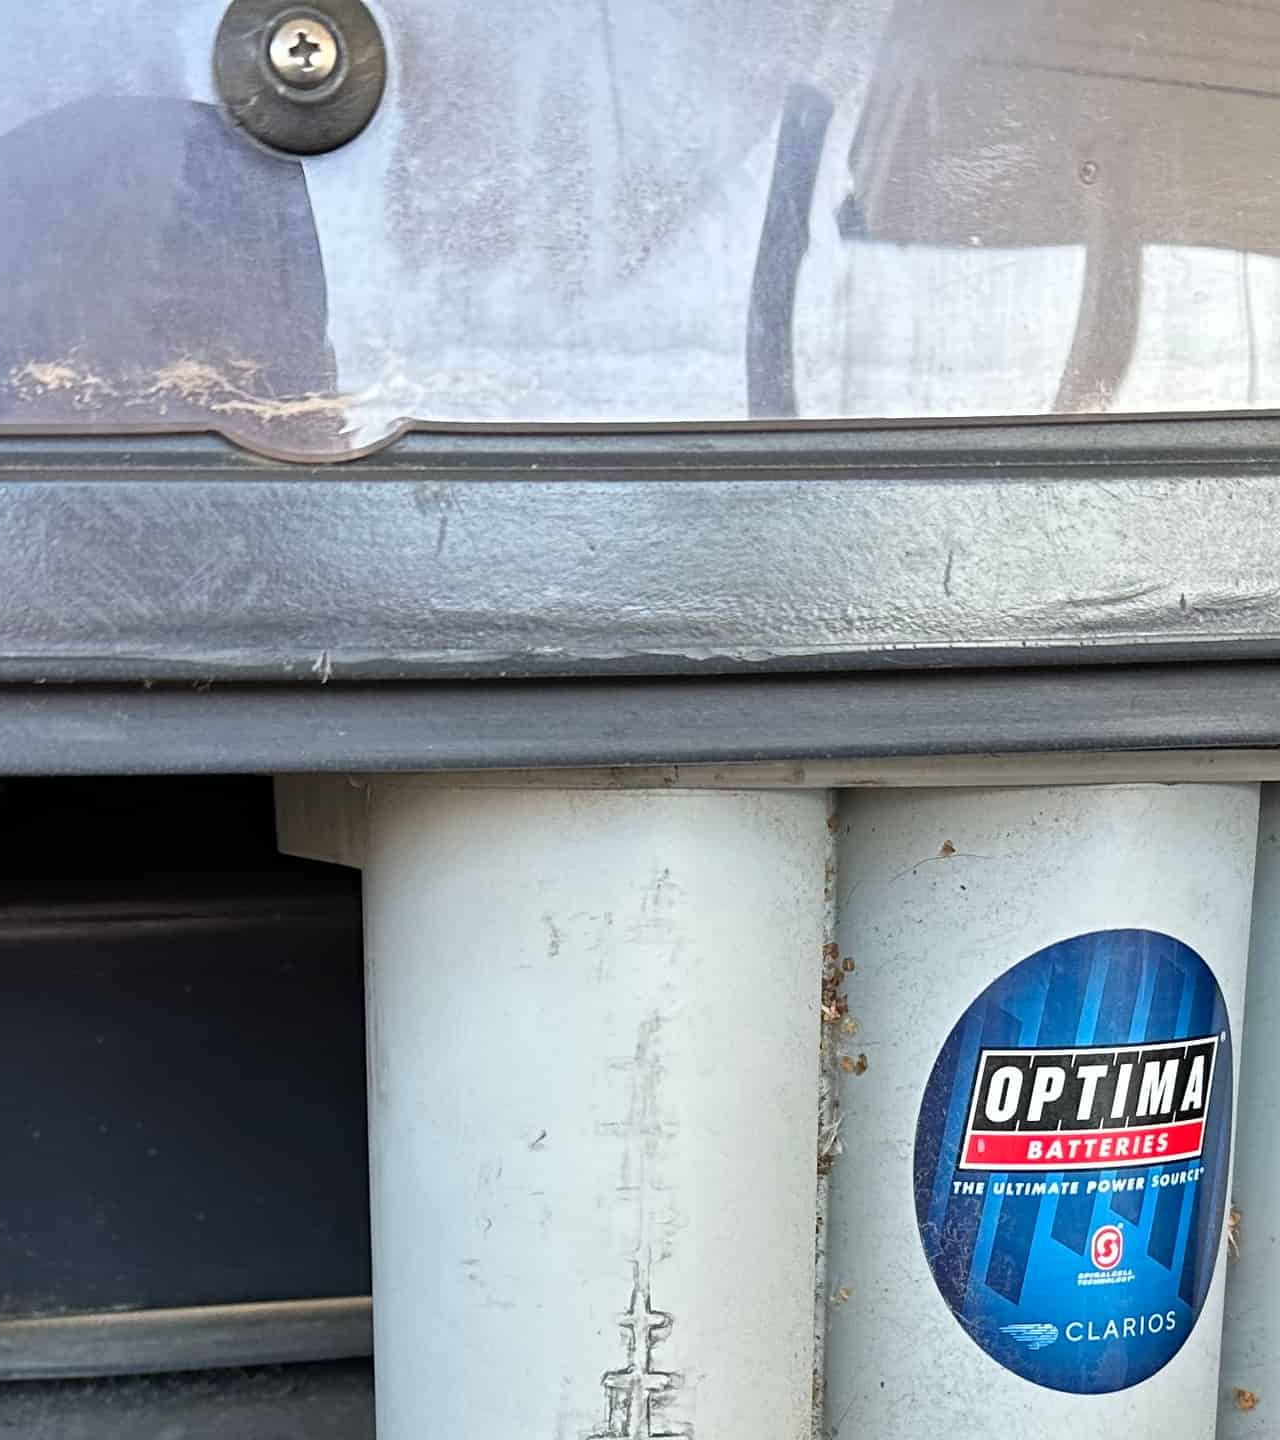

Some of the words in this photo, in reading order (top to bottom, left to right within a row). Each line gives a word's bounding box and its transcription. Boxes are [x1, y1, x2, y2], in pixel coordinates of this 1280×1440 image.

[984, 1055, 1207, 1123] OPTIMA
[1026, 1132, 1170, 1161] BATTERIES
[953, 1180, 985, 1196] THE
[992, 1180, 1081, 1197] ULTIMATE
[1086, 1176, 1146, 1195] POWER
[1151, 1168, 1200, 1189] SOURCE
[1065, 1310, 1177, 1342] CLARIOS
